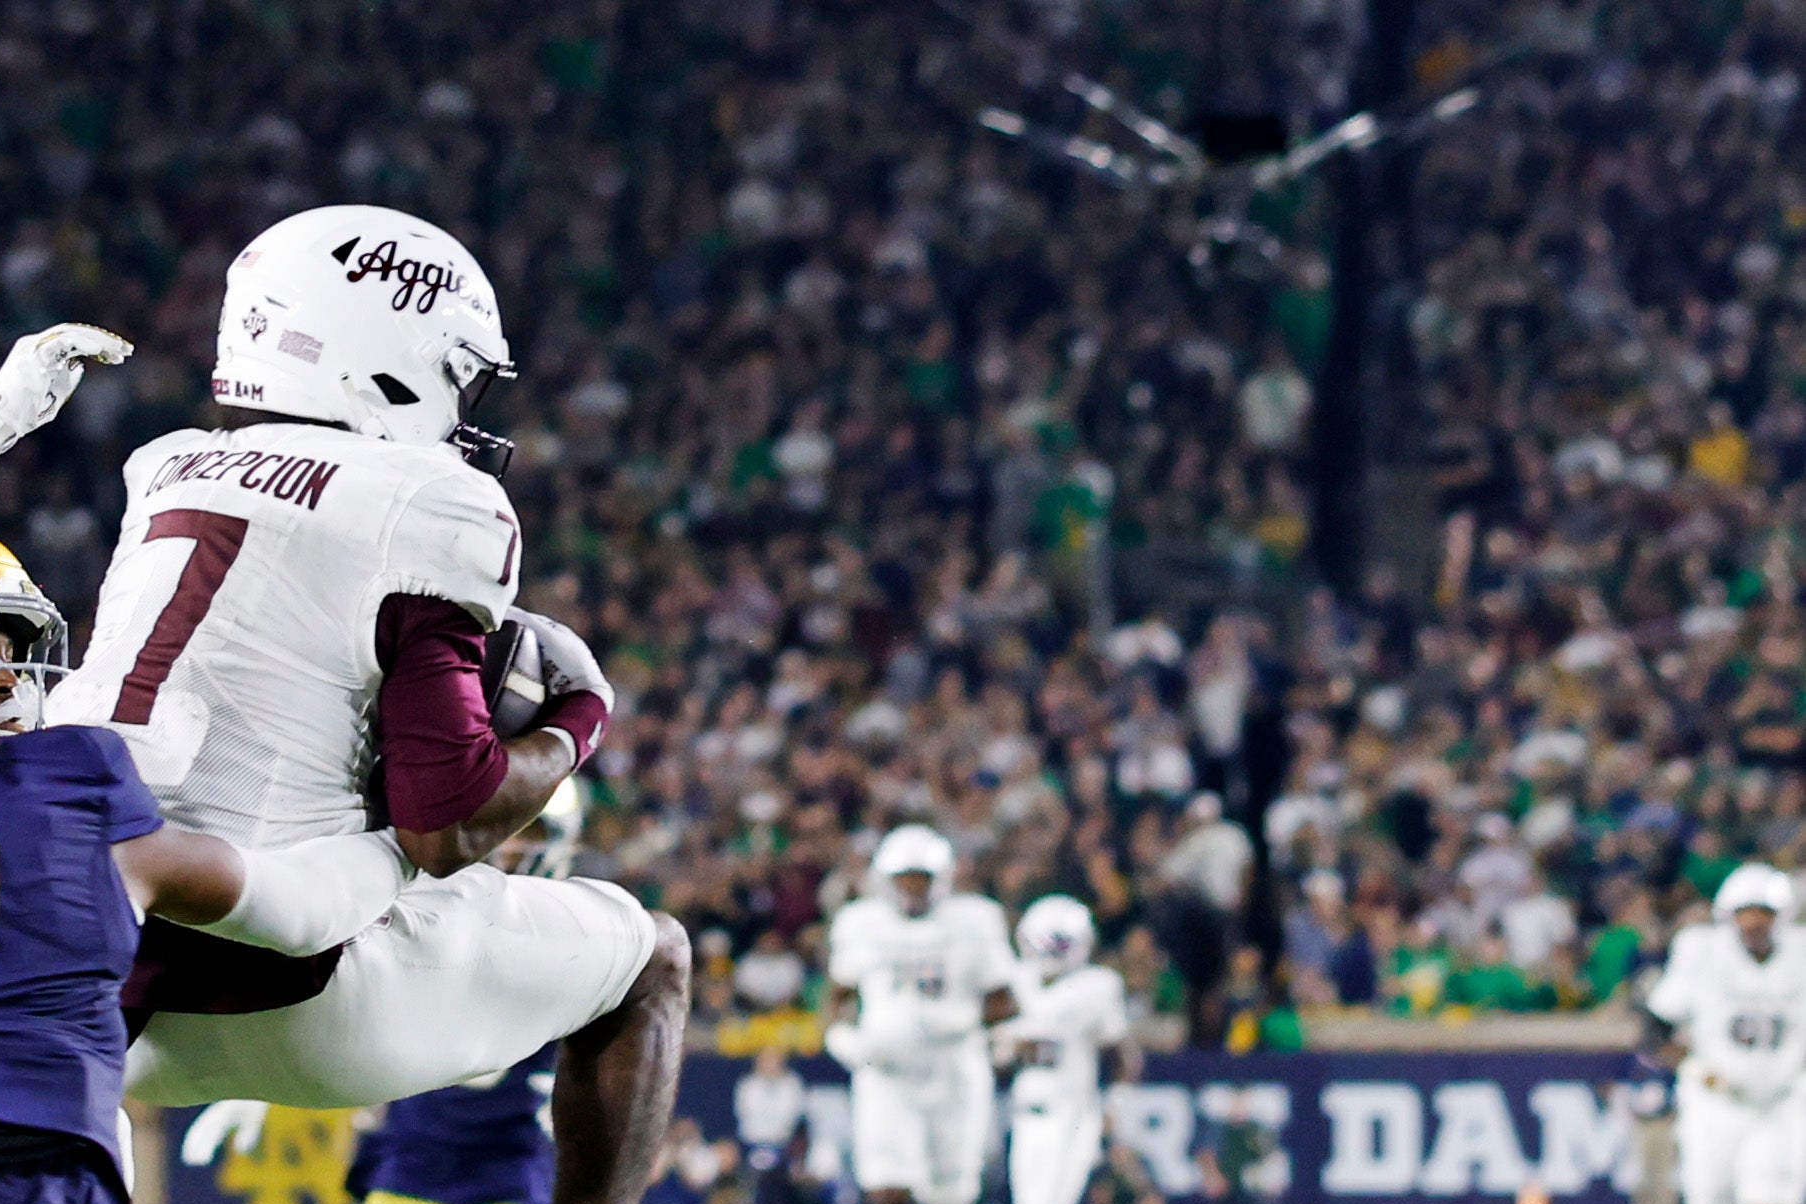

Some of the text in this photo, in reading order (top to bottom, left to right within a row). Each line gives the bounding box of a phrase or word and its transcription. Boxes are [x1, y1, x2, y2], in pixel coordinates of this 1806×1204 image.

[144, 450, 341, 511] CONCEPCION
[110, 508, 250, 726] 7
[1318, 1080, 1644, 1197] DAM
